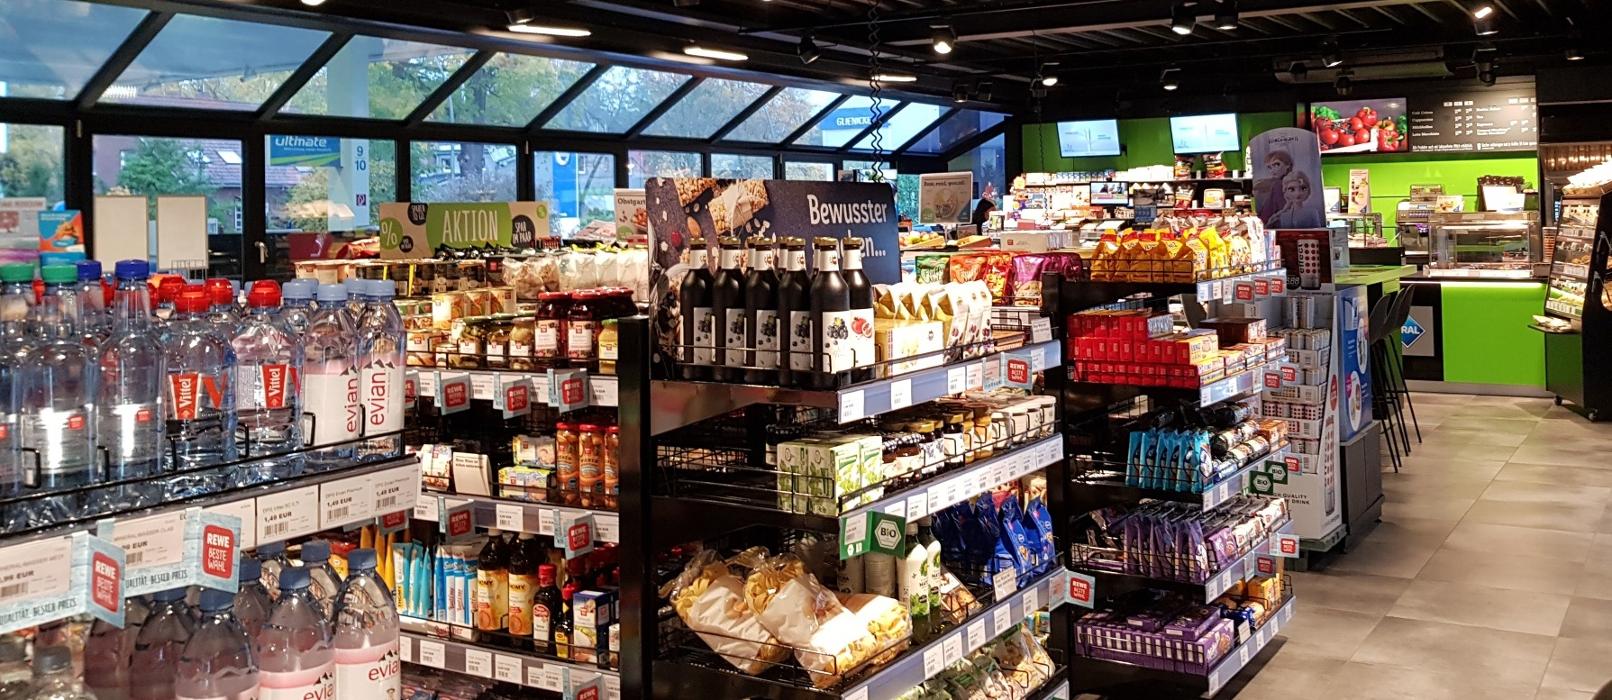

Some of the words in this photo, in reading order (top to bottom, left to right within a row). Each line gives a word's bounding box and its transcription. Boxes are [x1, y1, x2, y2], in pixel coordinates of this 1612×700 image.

[355, 160, 366, 171] 10
[356, 146, 364, 157] 9
[807, 194, 887, 225] Bewusster
[442, 209, 499, 243] AKTION
[268, 367, 281, 397] Vittel
[344, 377, 359, 433] evian
[367, 371, 386, 426] evian
[368, 659, 399, 681] evia
